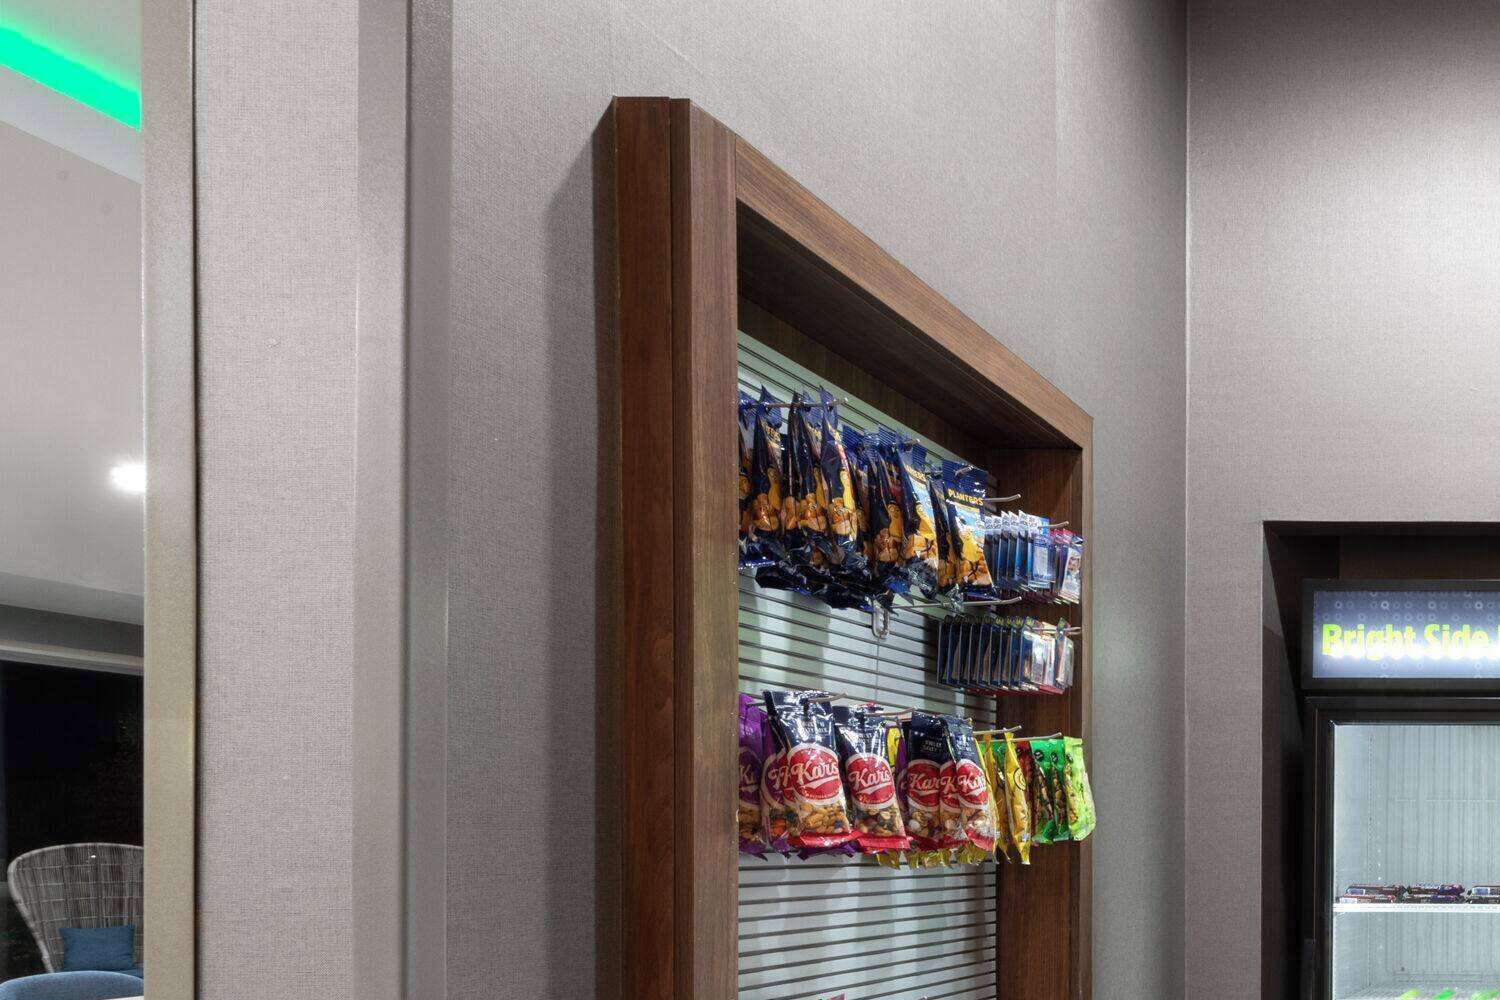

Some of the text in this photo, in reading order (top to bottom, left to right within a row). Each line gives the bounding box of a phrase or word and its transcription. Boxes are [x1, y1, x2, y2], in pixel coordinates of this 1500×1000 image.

[947, 488, 984, 507] PLANTERS
[1321, 623, 1417, 661] Bright
[1423, 623, 1491, 660] Side
